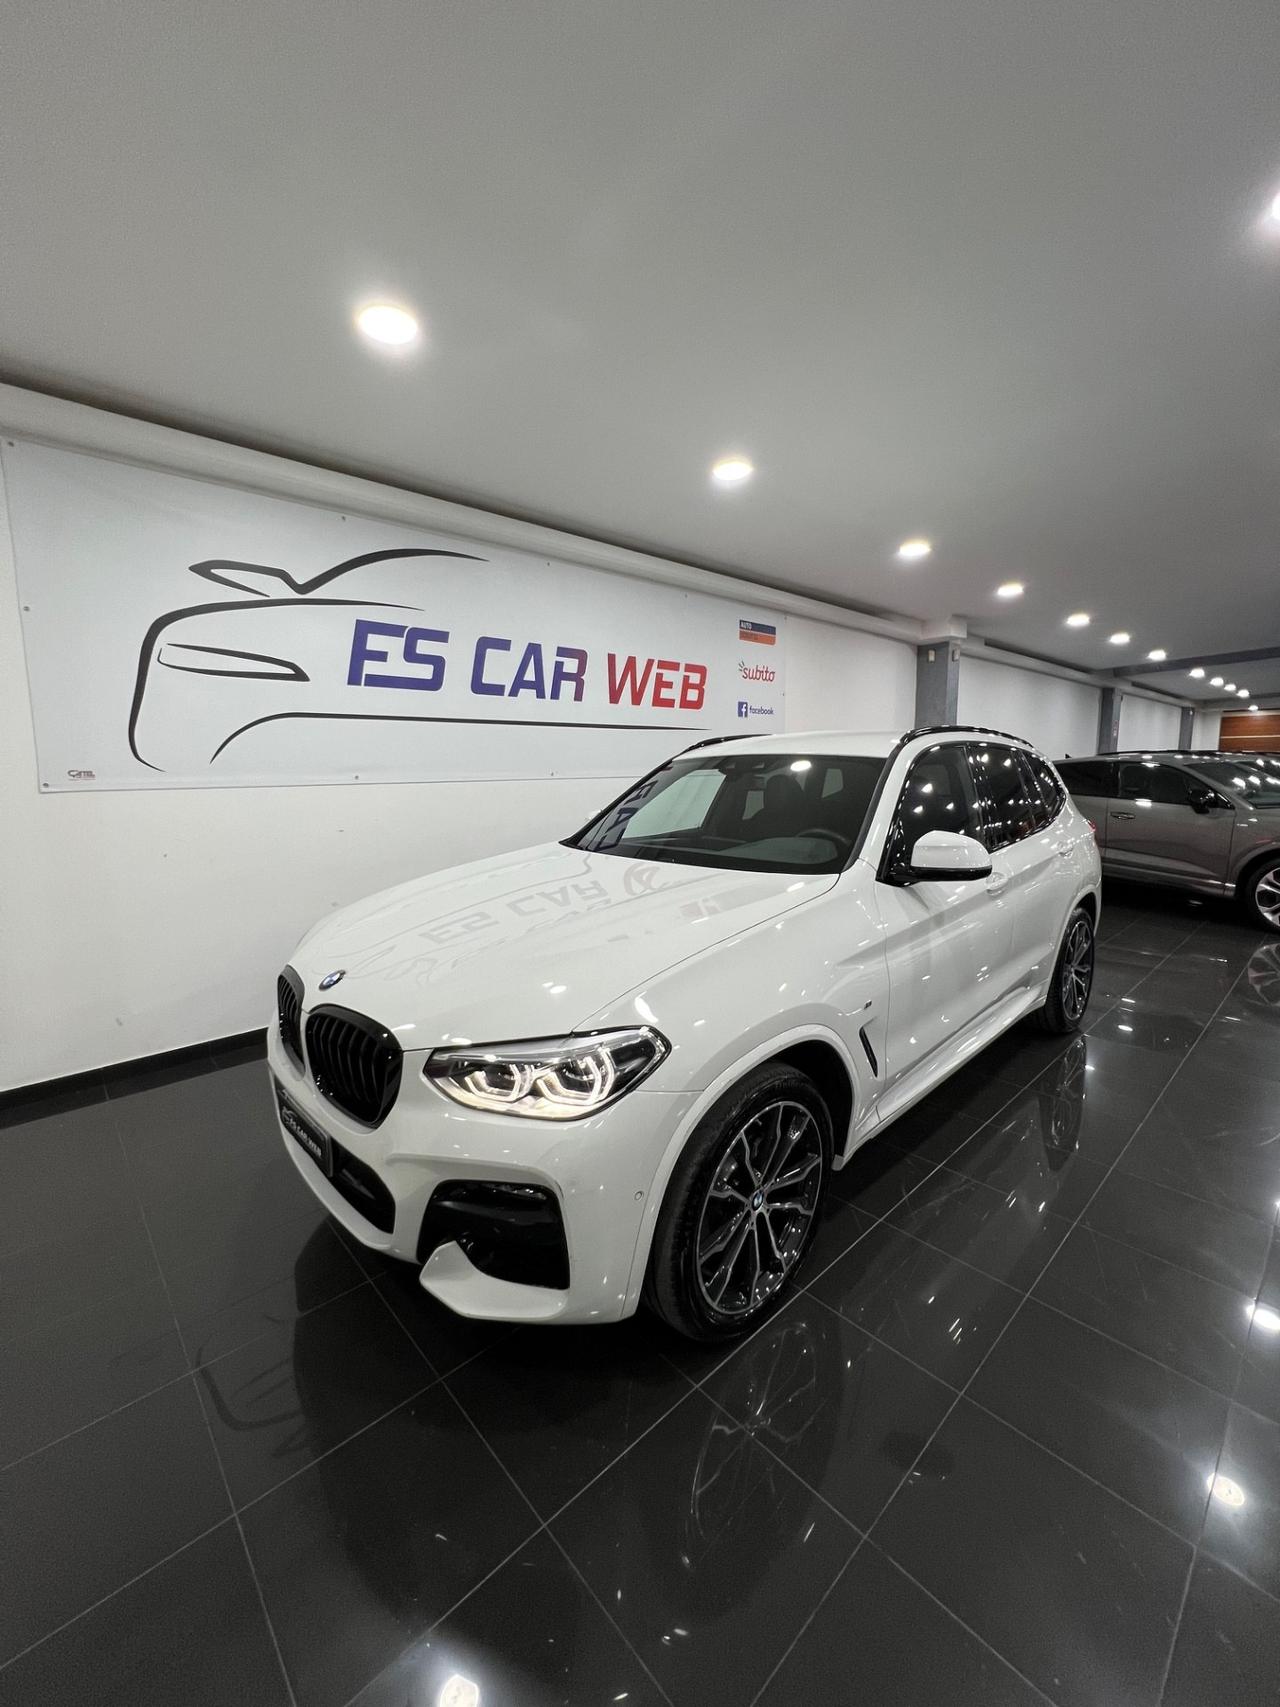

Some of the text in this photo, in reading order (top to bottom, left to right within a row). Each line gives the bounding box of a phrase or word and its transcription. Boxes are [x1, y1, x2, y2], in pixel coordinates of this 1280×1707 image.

[347, 619, 707, 710] ES CAR WEB
[743, 664, 776, 682] subito
[749, 705, 774, 716] facebook
